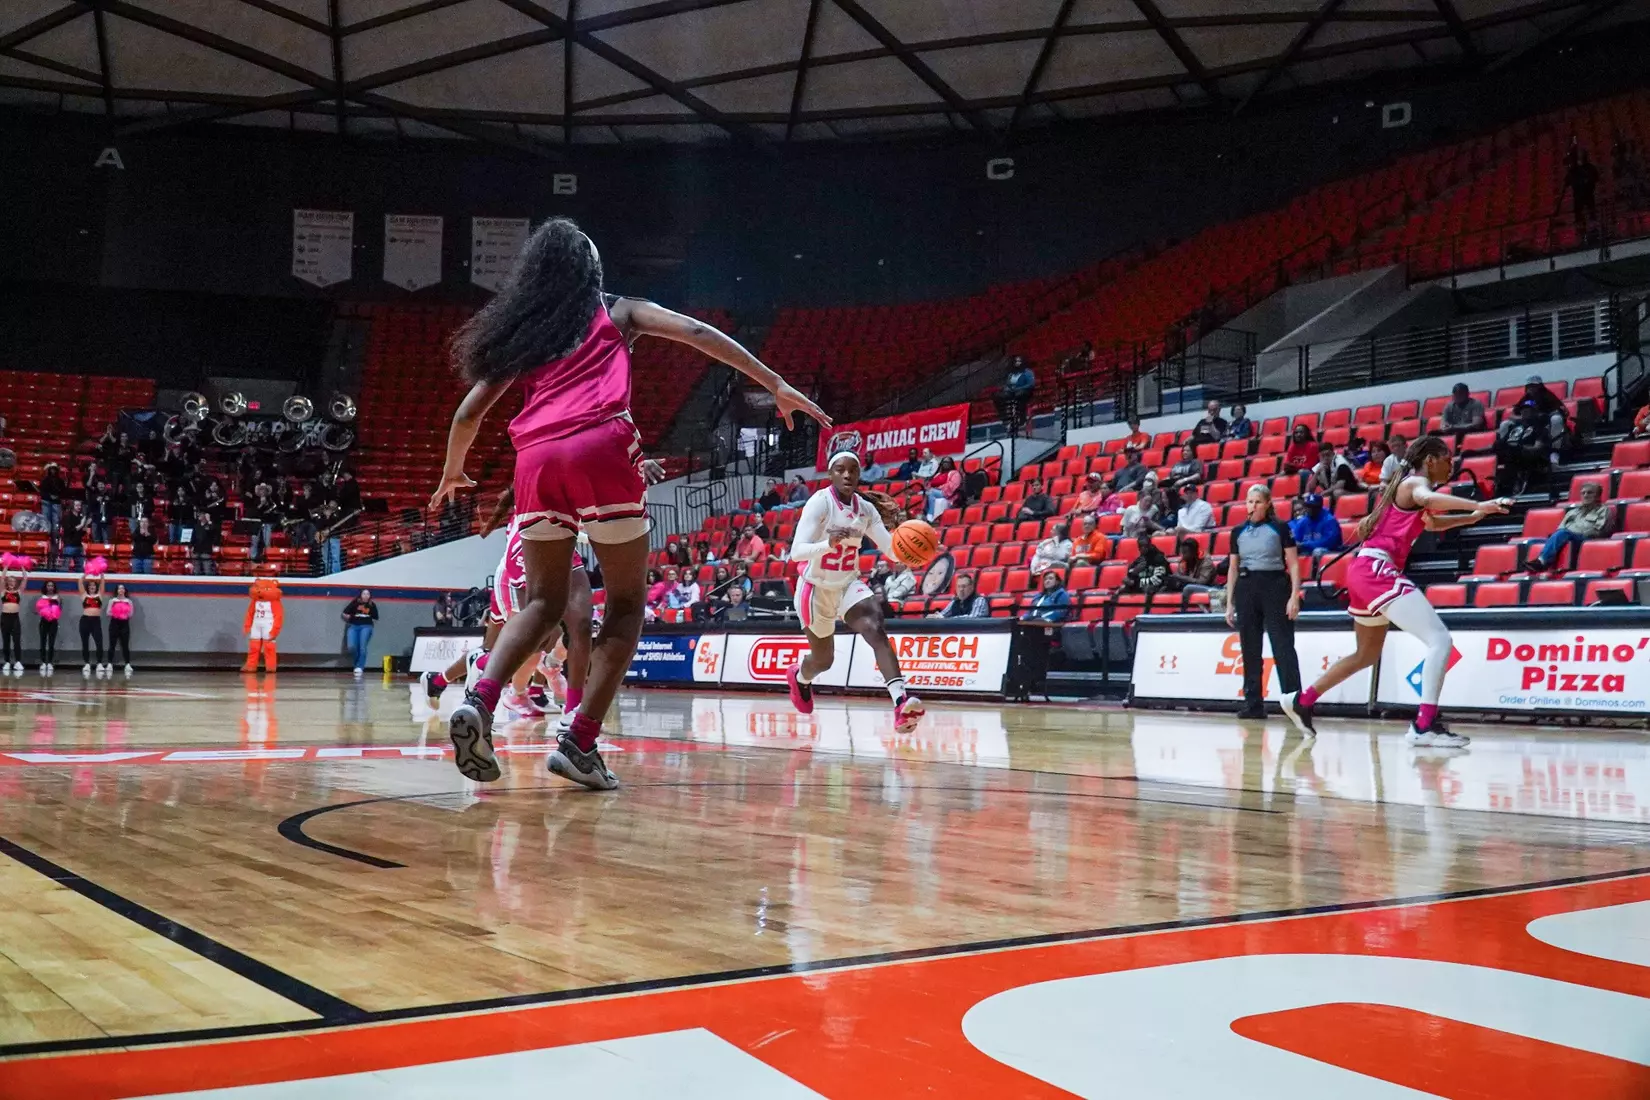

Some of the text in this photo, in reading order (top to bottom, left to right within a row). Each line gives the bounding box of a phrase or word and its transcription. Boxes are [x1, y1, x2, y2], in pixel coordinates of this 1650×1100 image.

[1382, 102, 1411, 128] D
[94, 147, 125, 169] A
[986, 157, 1015, 180] C
[552, 173, 578, 195] B
[866, 419, 961, 451] CANIAC CREW
[820, 544, 857, 571] 22
[1486, 636, 1650, 662] Domino'
[912, 662, 957, 671] LIGHTING,
[960, 662, 977, 671] INC.
[1521, 665, 1625, 692] Pizza
[1499, 695, 1526, 704] Order
[1529, 696, 1561, 705] Online
[1575, 697, 1645, 708] Dominos.com
